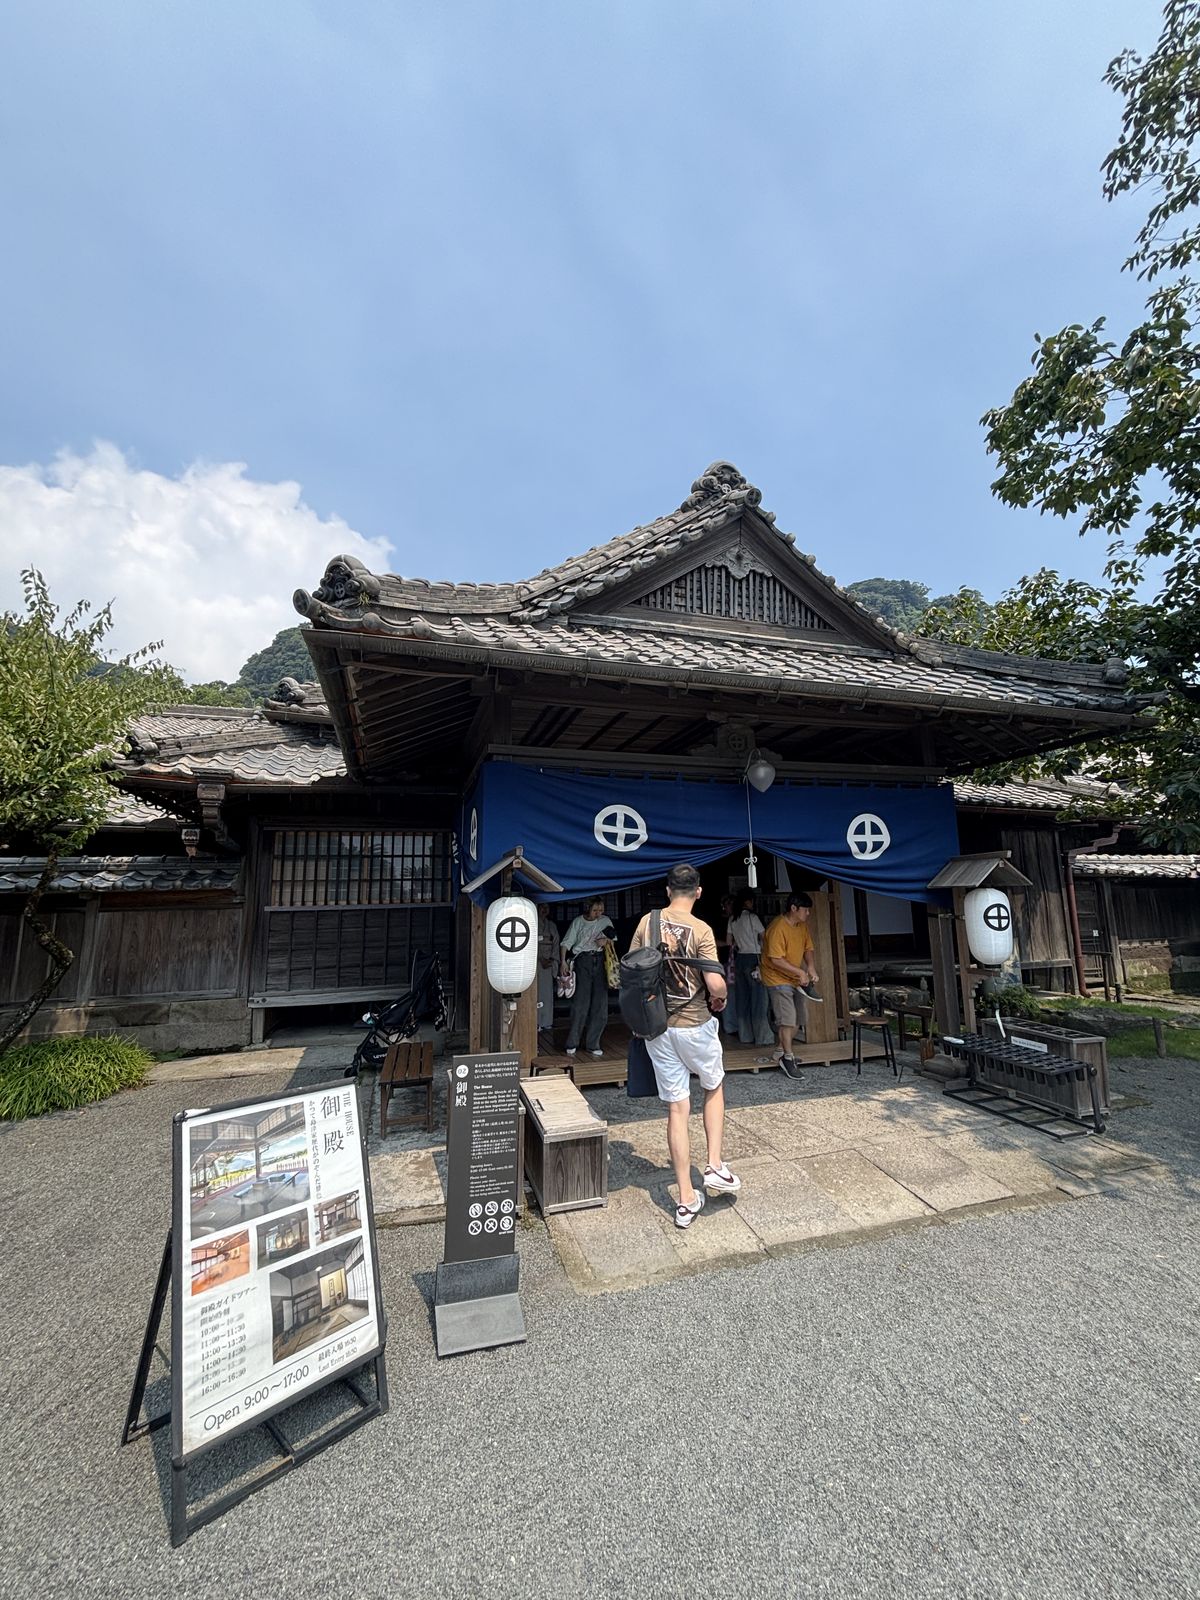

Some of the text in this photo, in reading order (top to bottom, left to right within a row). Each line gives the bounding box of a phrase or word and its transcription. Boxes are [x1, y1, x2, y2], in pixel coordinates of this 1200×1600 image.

[456, 1082, 468, 1106] 御殿
[320, 1095, 344, 1156] 御殿
[343, 1091, 354, 1137] THE HOUSE
[204, 1403, 240, 1431] Open
